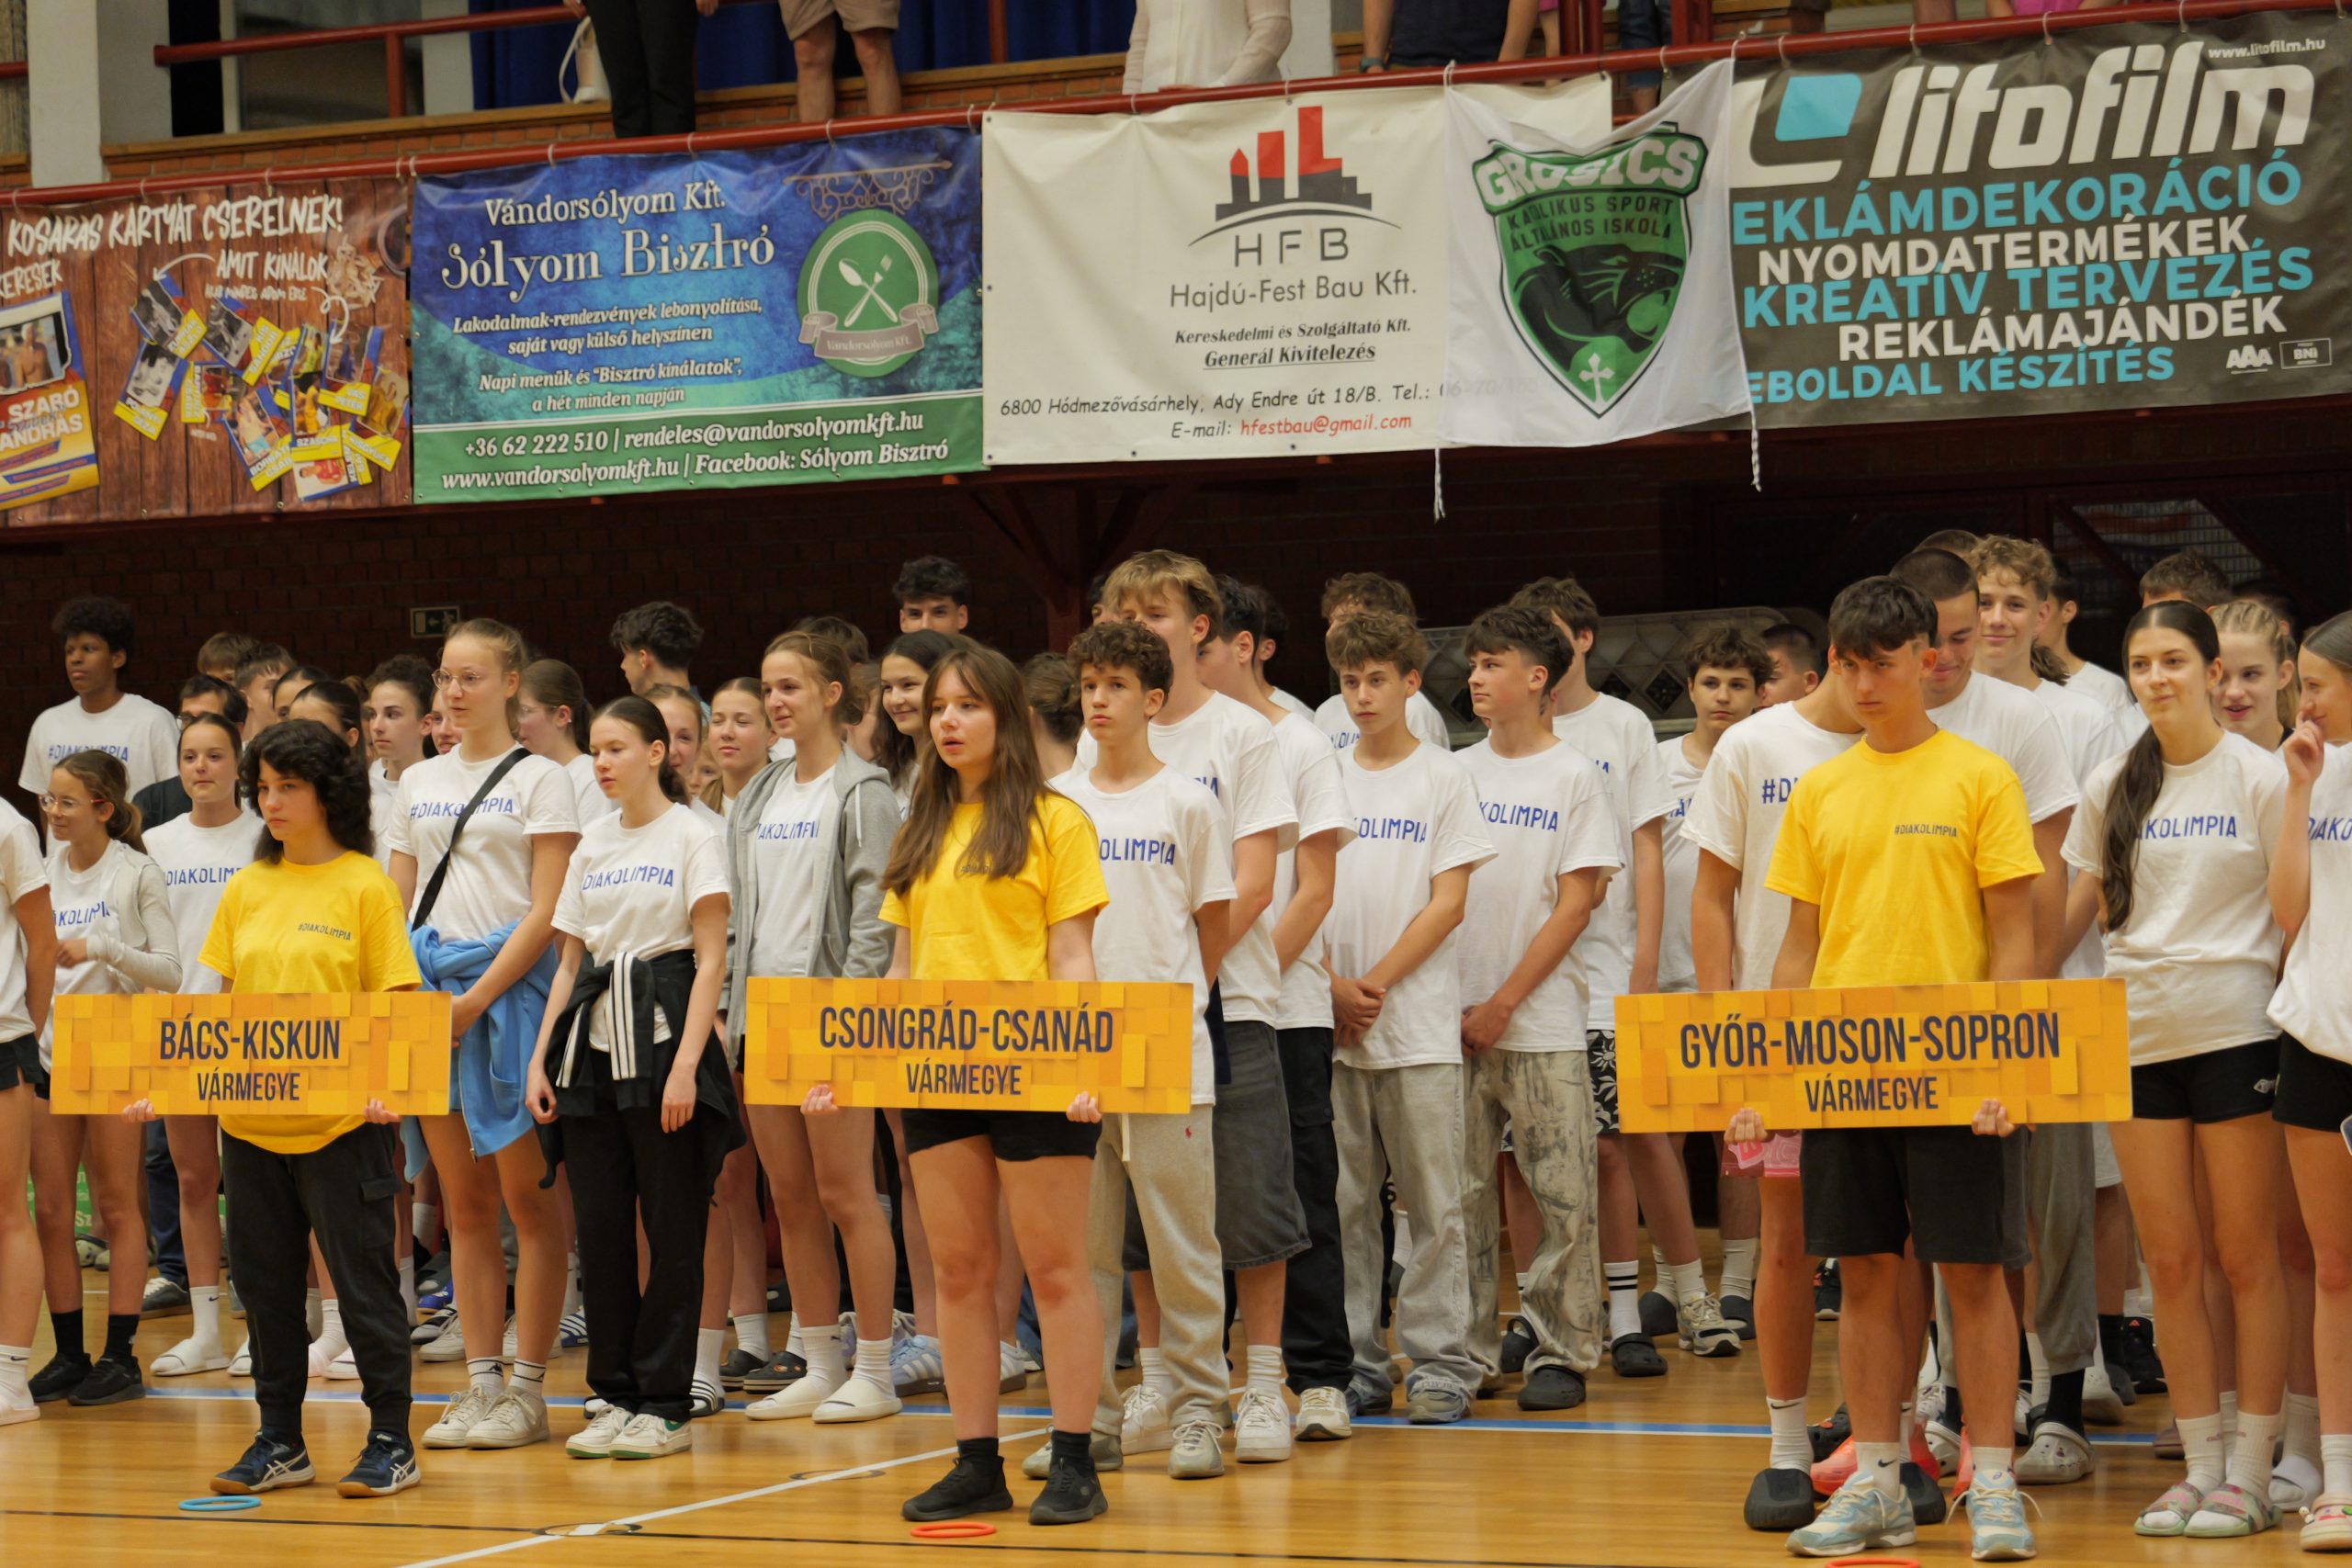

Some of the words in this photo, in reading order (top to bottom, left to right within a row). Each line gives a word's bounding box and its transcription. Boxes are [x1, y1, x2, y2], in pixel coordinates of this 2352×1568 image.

[2208, 39, 2325, 58] www.litofilm.hu
[1869, 41, 2314, 178] litofilm
[1474, 139, 1699, 208] GROSICS
[485, 188, 675, 226] Vándorsólyom
[683, 179, 726, 210] Kft.
[1606, 196, 1673, 215] SPORT
[1733, 148, 2301, 244] EKLÁMDEKORÁCIÓ
[7, 214, 104, 257] KOSARAS
[1602, 218, 1671, 239] ISKOLA
[217, 249, 259, 279] AMIT
[442, 240, 603, 303] Sólyom
[621, 222, 775, 277] Bisztró
[1758, 213, 2249, 286] NYOMDATERMÉKEK
[1170, 279, 1306, 312] Hajdú-Fest
[1316, 275, 1363, 299] Bau
[1375, 269, 1417, 296] Kft.
[1745, 263, 1988, 328] KREATÍV
[2007, 238, 2312, 310] TERVEZÉS
[453, 304, 656, 334] Lakodalmak-rendezvények
[661, 298, 763, 321] lebonyolítása,
[1174, 324, 1273, 344] Kereskedelmi
[1278, 325, 1293, 339] és
[1296, 320, 1381, 338] Szolgáltató
[1385, 318, 1411, 333] Kft.
[1839, 289, 2287, 361] REKLÁMAJÁNDÉK
[508, 336, 547, 356] saját
[549, 339, 584, 355] vagy
[586, 330, 628, 349] külső
[631, 326, 713, 348] helyszínen
[1204, 346, 1274, 367] Generál
[1278, 343, 1376, 363] Kivitelezés
[479, 373, 516, 393] Napi
[519, 368, 573, 389] menük
[575, 369, 590, 385] és
[1747, 362, 1942, 404] EBOLDAL
[1958, 340, 2174, 393] KÉSZÍTÉS
[532, 400, 542, 412] a
[547, 395, 571, 411] hét
[574, 391, 631, 409] minden
[635, 387, 684, 408] napján
[1001, 399, 1042, 416] 6800
[1048, 395, 1204, 415] Hódmezővásárhely,
[1213, 389, 1244, 412] Ady
[1251, 389, 1298, 409] Endre
[1307, 388, 1325, 405] út
[1333, 385, 1382, 404] 18/B.
[1392, 383, 1430, 400] Tel.:
[465, 437, 497, 457] +36
[502, 435, 527, 456] 62
[531, 433, 569, 455] 222
[573, 430, 608, 452] 510
[624, 411, 923, 448] rendeles@vandorsolyomkft.hu
[1171, 420, 1231, 438] E-mail:
[1240, 413, 1411, 436] hfestbau@gmail.com
[442, 457, 679, 489] www.vandorsolyomkft.hu
[694, 450, 796, 474] Facebook:
[799, 446, 873, 472] Sólyom
[877, 438, 948, 464] Bisztró
[1355, 817, 1427, 843] OLIMPIA
[1099, 838, 1176, 865] OLIMPIA
[160, 1012, 340, 1060] BÁCS-KISKUN
[819, 1000, 1114, 1054] CSONGRÁD-CSANÁD
[1679, 1011, 2060, 1069] GYŐR-MOSON-SOPRON
[197, 1066, 300, 1101] VÁRMEGYE
[906, 1057, 1023, 1096] VÁRMEGYE
[1804, 1071, 1939, 1112] VÁRMEGYE
